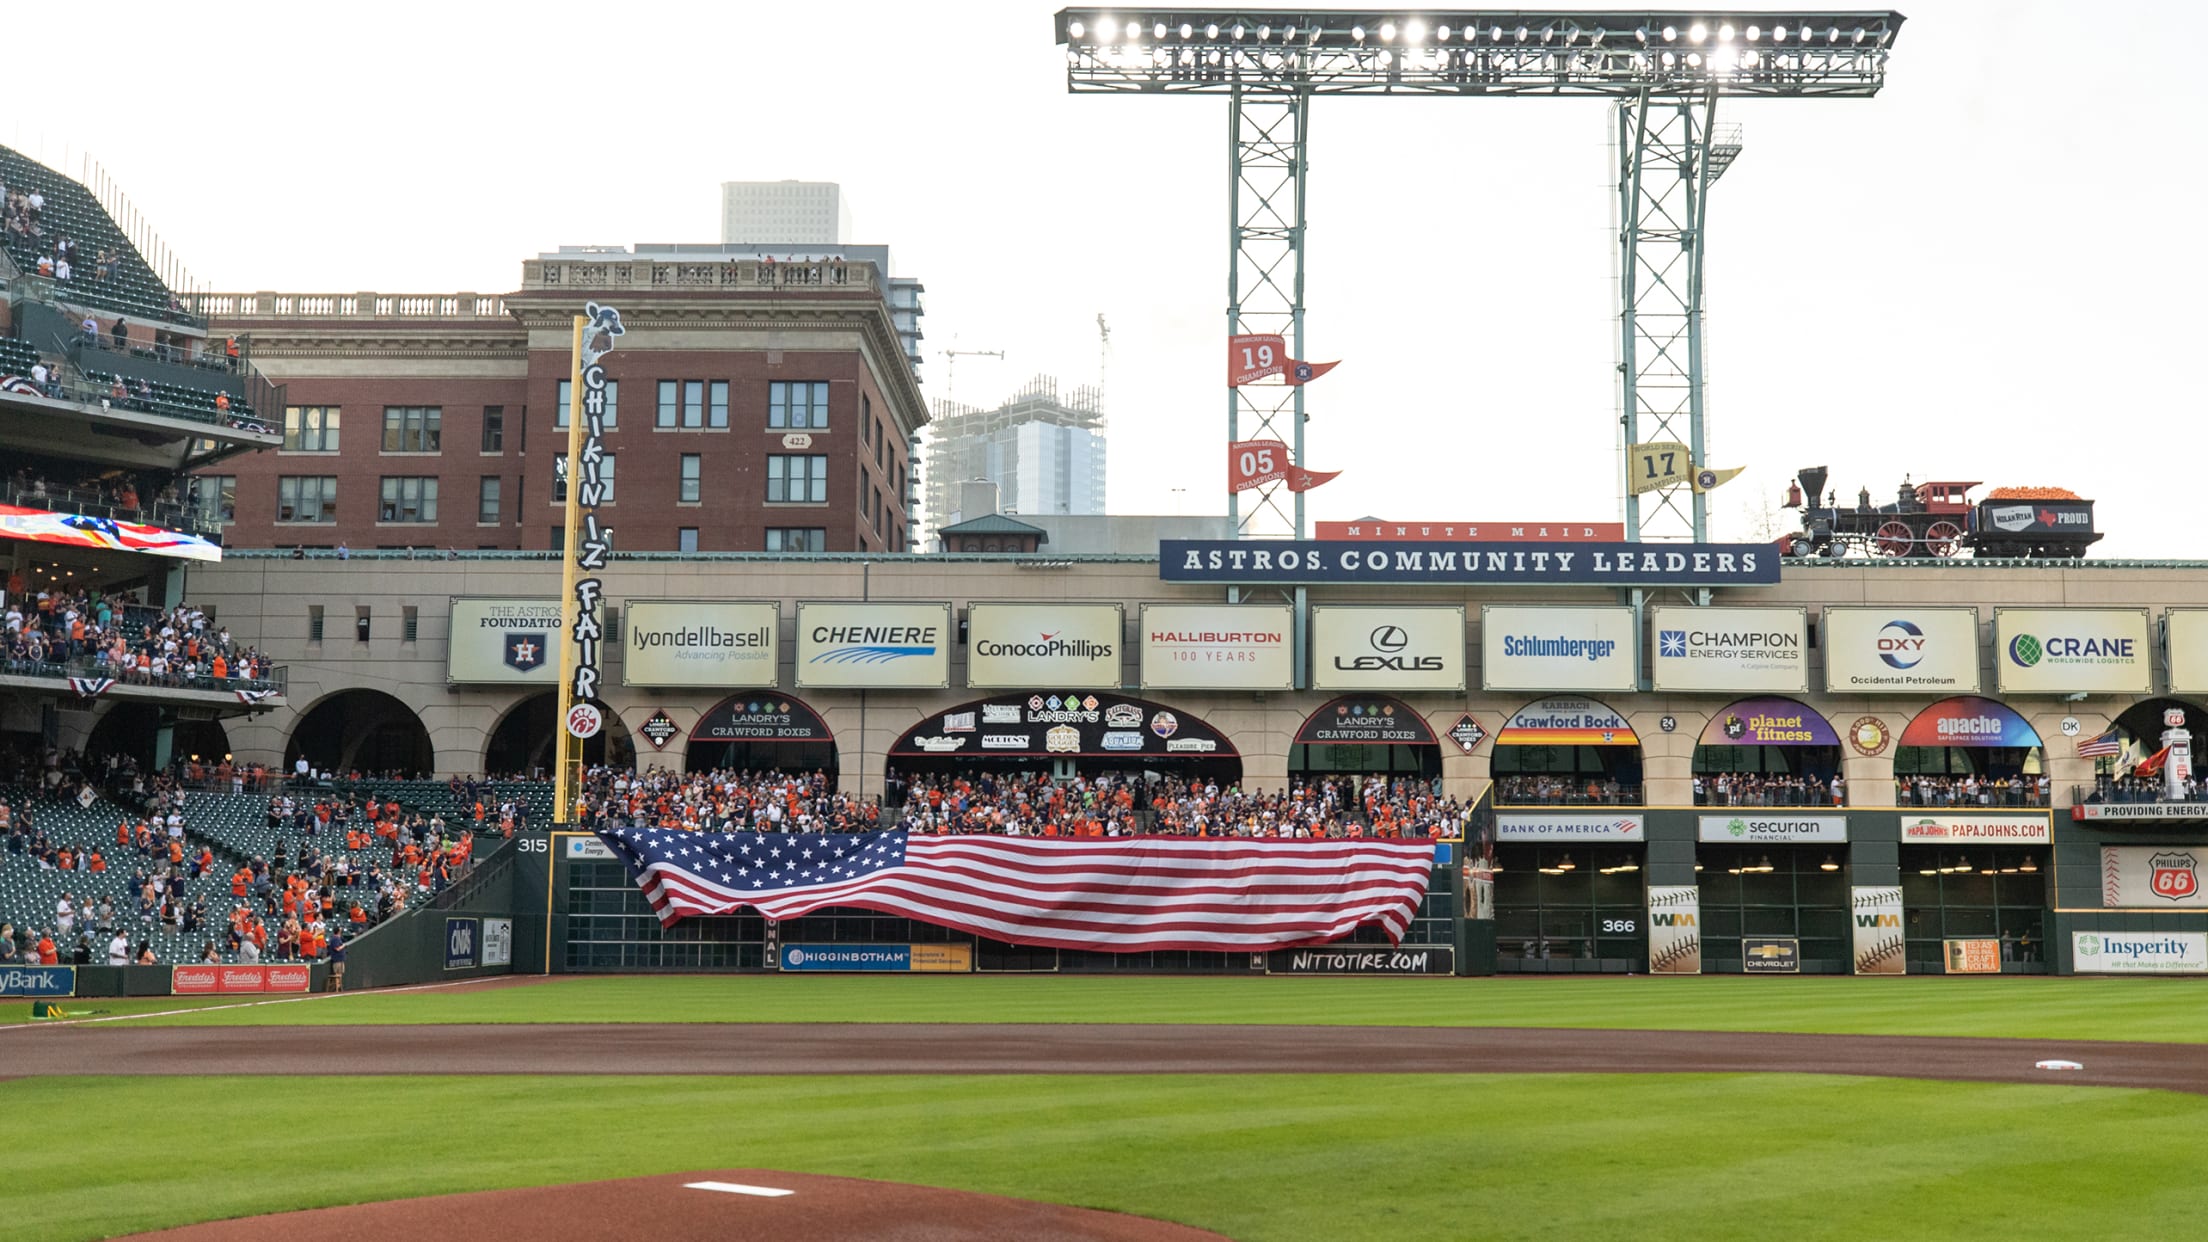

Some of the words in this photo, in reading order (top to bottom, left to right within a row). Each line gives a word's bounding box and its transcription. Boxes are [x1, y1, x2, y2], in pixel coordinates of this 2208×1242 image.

[1242, 345, 1274, 370] 19
[1236, 365, 1284, 384] CHAMPIONS
[582, 366, 606, 506] CHIKIN
[788, 437, 806, 446] 422
[1240, 449, 1274, 477] 05
[1643, 452, 1675, 479] 17
[1235, 471, 1286, 491] CHAMPIONS
[1637, 473, 1687, 494] CHAMPIONS
[2057, 512, 2089, 524] PROUD
[1348, 526, 1478, 537] MINUTE
[581, 515, 607, 568] IZ
[1340, 551, 1574, 572] COMMUNITY
[1593, 552, 1757, 573] LEADERS
[489, 606, 523, 617] THE
[524, 606, 563, 618] ASTROS
[480, 618, 564, 628] FOUNDATIO
[576, 581, 600, 698] FAIR
[633, 626, 770, 650] lyondellbasell
[812, 626, 937, 644] CHENIERE
[1151, 632, 1282, 643] HALLIBURTON
[1689, 631, 1799, 647] CHAMPION
[976, 639, 1112, 661] ConocoPhillips
[1504, 635, 1615, 661] Schlumberger
[1877, 638, 1926, 651] OXY
[2045, 637, 2135, 657] CRANE
[674, 650, 726, 662] Advancing
[728, 650, 769, 661] Possible
[1173, 651, 1198, 662] 100
[1206, 651, 1256, 662] YEARS
[1690, 650, 1739, 658] ENERGY
[1740, 650, 1799, 659] SERVICES
[1334, 656, 1444, 671] LEXUS
[1850, 676, 1904, 684] Occidental
[1905, 676, 1956, 685] Petroleum
[1541, 702, 1590, 710] KARBACH
[732, 714, 790, 723] LANDRY'S
[1028, 711, 1099, 723] LANDRY'S
[1336, 717, 1395, 726] LANDRY'S
[1515, 715, 1582, 728] Crawford
[1584, 715, 1620, 728] Bock
[1662, 718, 1674, 727] 24
[1749, 714, 1802, 730] planet
[2169, 716, 2183, 724] 66
[1937, 715, 2002, 735] apache
[2062, 721, 2078, 731] DK
[711, 727, 773, 736] CRAWFORD
[777, 727, 811, 737] BOXES
[1316, 730, 1379, 739] CRAWFORD
[1382, 731, 1416, 740] BOXES
[1756, 727, 1813, 742] fitness
[983, 735, 1028, 744] MORTON'S
[2104, 806, 2163, 816] PROVIDING
[1502, 824, 1537, 833] BANK
[1539, 824, 1554, 833] OF
[1556, 824, 1610, 834] AMERICA
[1749, 819, 1820, 834] securian
[1907, 827, 1924, 836] PAPA
[1952, 824, 2045, 837] PAPAJOHNS.COM
[517, 838, 548, 853] 315
[584, 847, 605, 856] Energy
[2155, 859, 2191, 868] PHILLIPS
[2158, 872, 2189, 890] 66
[1602, 919, 1636, 933] 366
[1652, 913, 1696, 927] WM
[1855, 914, 1900, 928] WM
[1967, 941, 1993, 950] TEXAS
[2103, 937, 2188, 958] Insperity
[805, 952, 904, 962] HIGGINBOTHAM
[1293, 950, 1428, 973] NITTOTIRE.COM
[1967, 954, 1996, 962] CRAFT
[1968, 961, 1997, 970] VODKA
[176, 971, 215, 984] Freddy's
[223, 970, 262, 983] Freddy's
[269, 970, 307, 983] Freddy's
